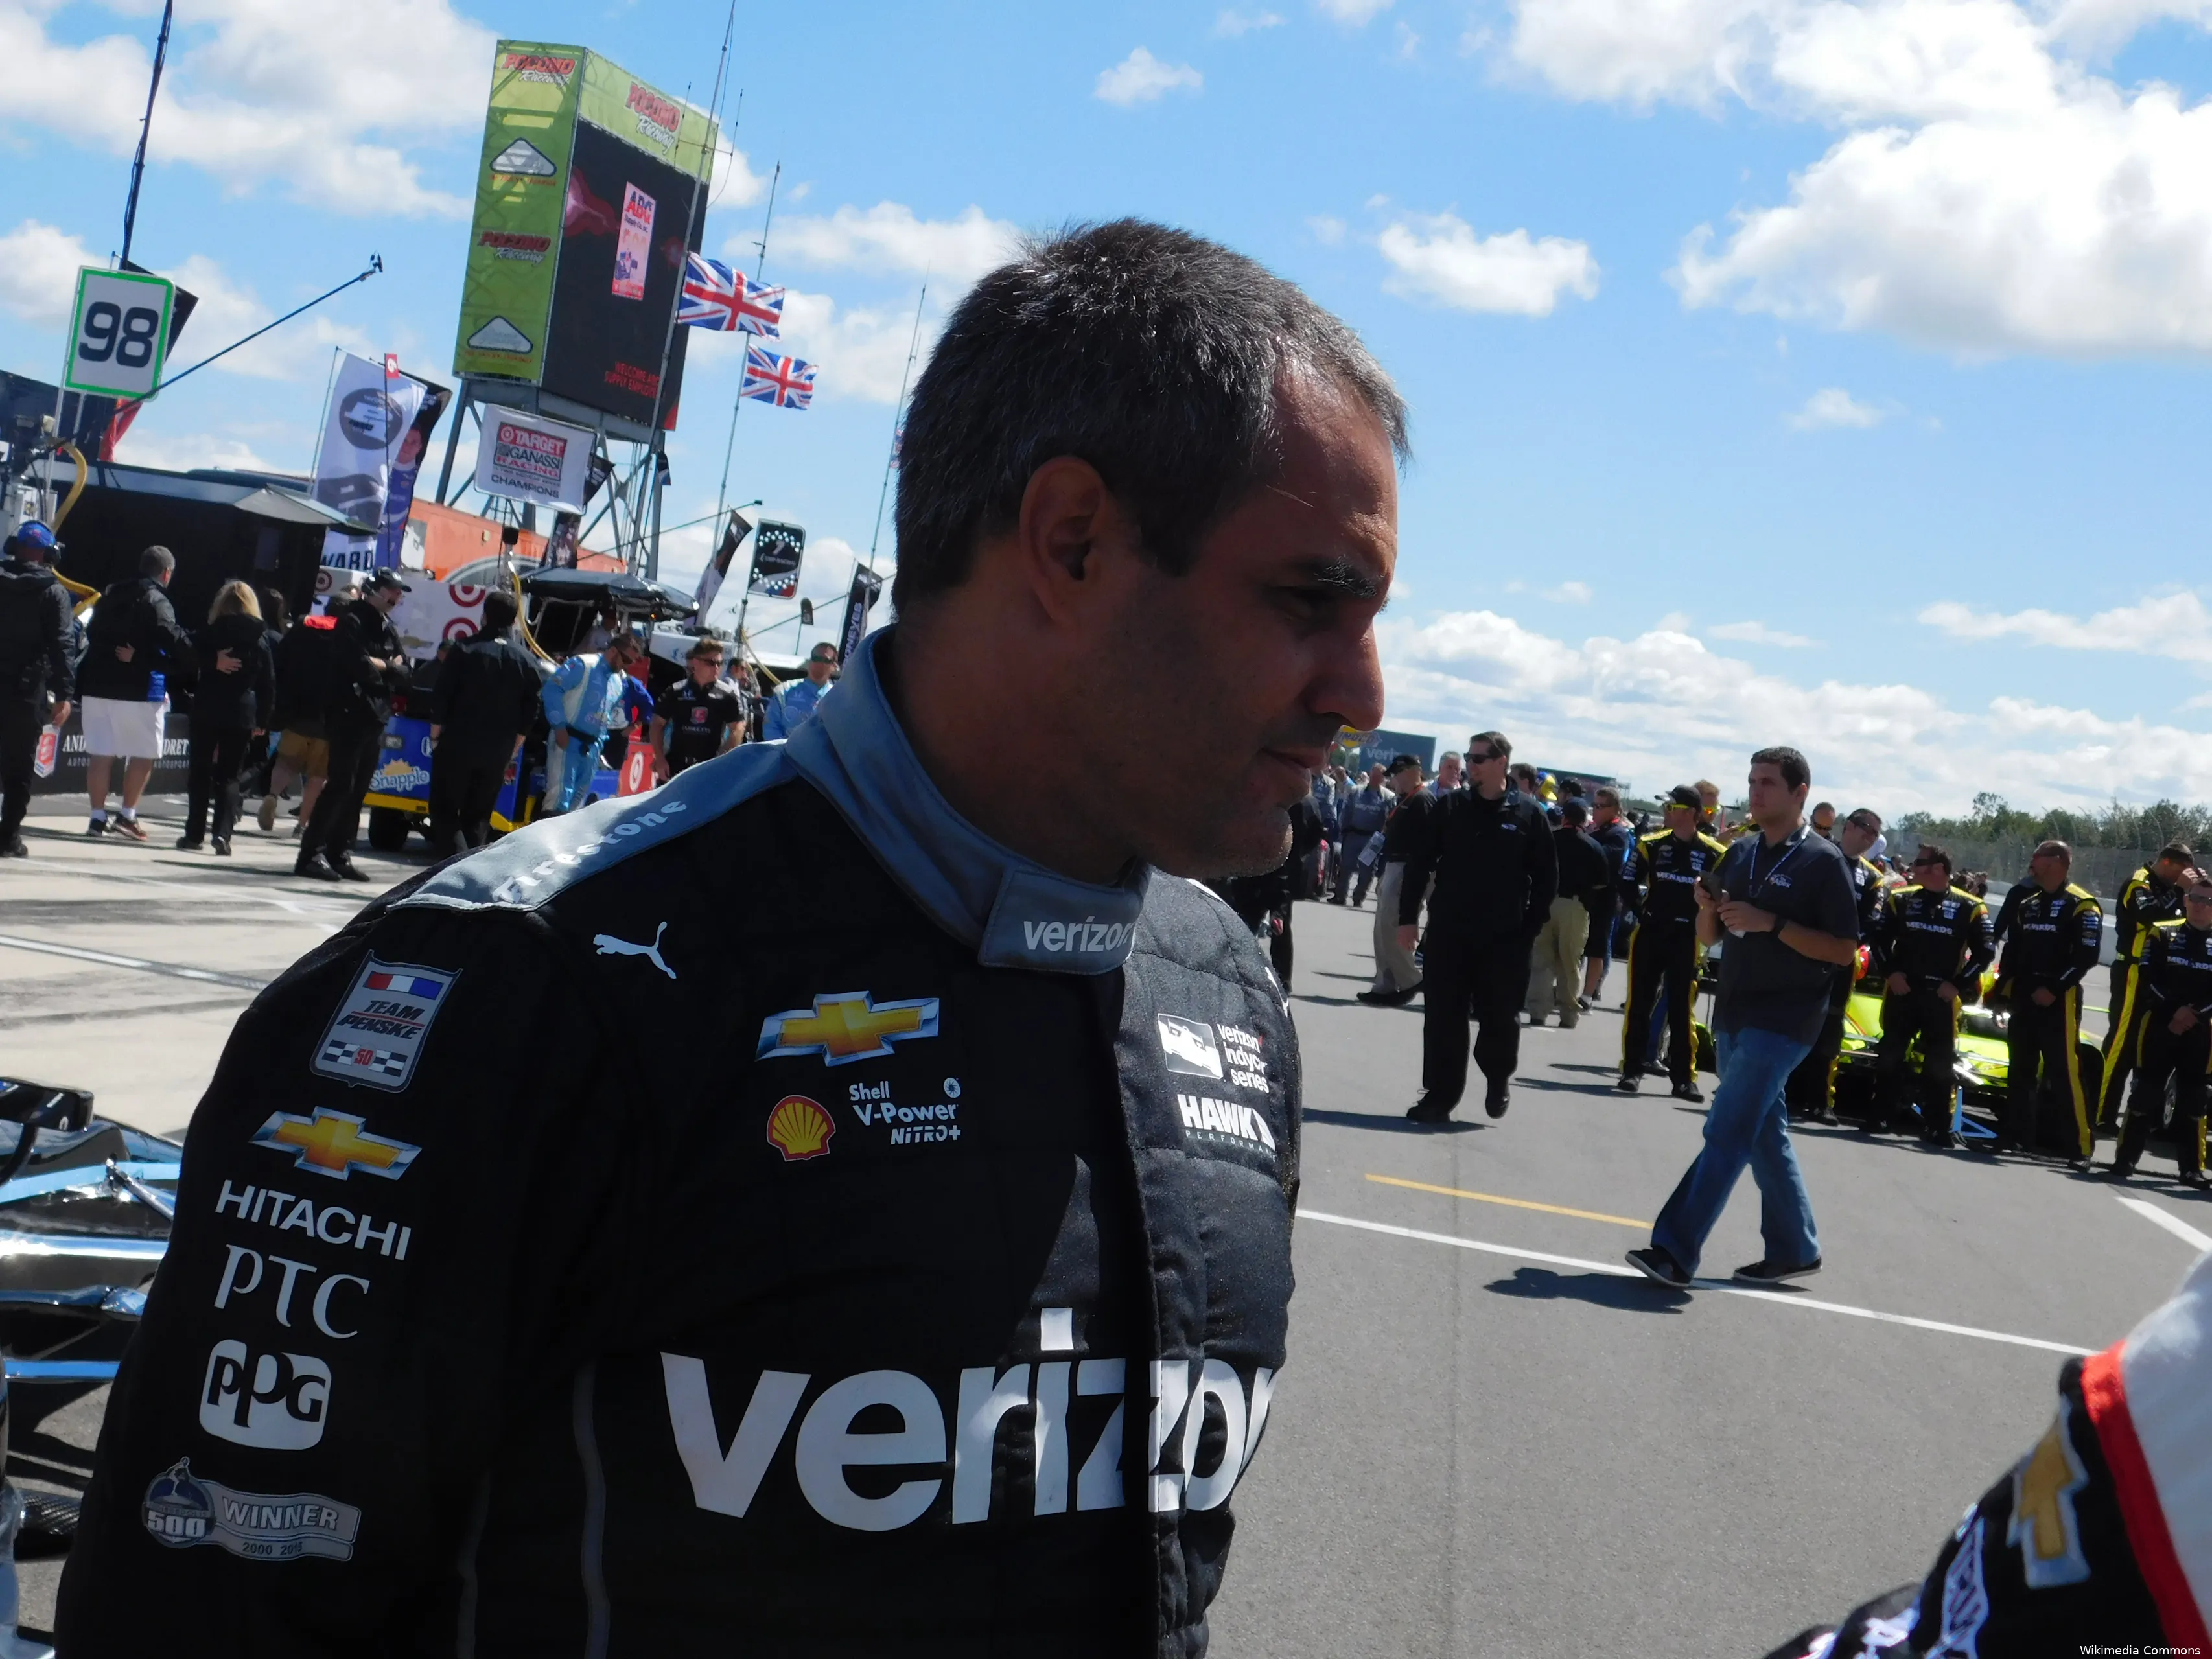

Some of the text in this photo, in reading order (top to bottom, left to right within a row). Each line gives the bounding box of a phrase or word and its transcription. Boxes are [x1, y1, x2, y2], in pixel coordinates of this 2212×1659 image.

[502, 53, 576, 75] POCONO
[519, 69, 570, 87] Raceway
[625, 81, 680, 132] POCONO
[636, 114, 675, 156] Raceway
[478, 231, 551, 253] POCONO
[494, 248, 546, 265] Raceway
[78, 301, 159, 368] 98
[515, 430, 564, 456] TARGET
[496, 456, 558, 478] RACING
[510, 447, 559, 469] GANASSI
[491, 474, 559, 498] CHAMPIONS
[369, 766, 430, 793] Snapple
[492, 800, 687, 903] Firestone
[1023, 909, 1134, 952] verizon
[364, 1000, 425, 1021] TEAM
[336, 1015, 425, 1039] PENSKE
[1217, 1023, 1261, 1054] verizon
[354, 1049, 374, 1066] 50
[1223, 1041, 1268, 1074] indycar
[848, 1080, 891, 1101] Shell
[1230, 1068, 1269, 1093] series
[852, 1102, 958, 1126] V-Power
[1177, 1093, 1259, 1141] HAWK
[215, 1179, 412, 1261] HITACHI
[147, 1510, 205, 1537] 500
[222, 1497, 338, 1531] WINNER
[242, 1541, 303, 1556] 2000 2015
